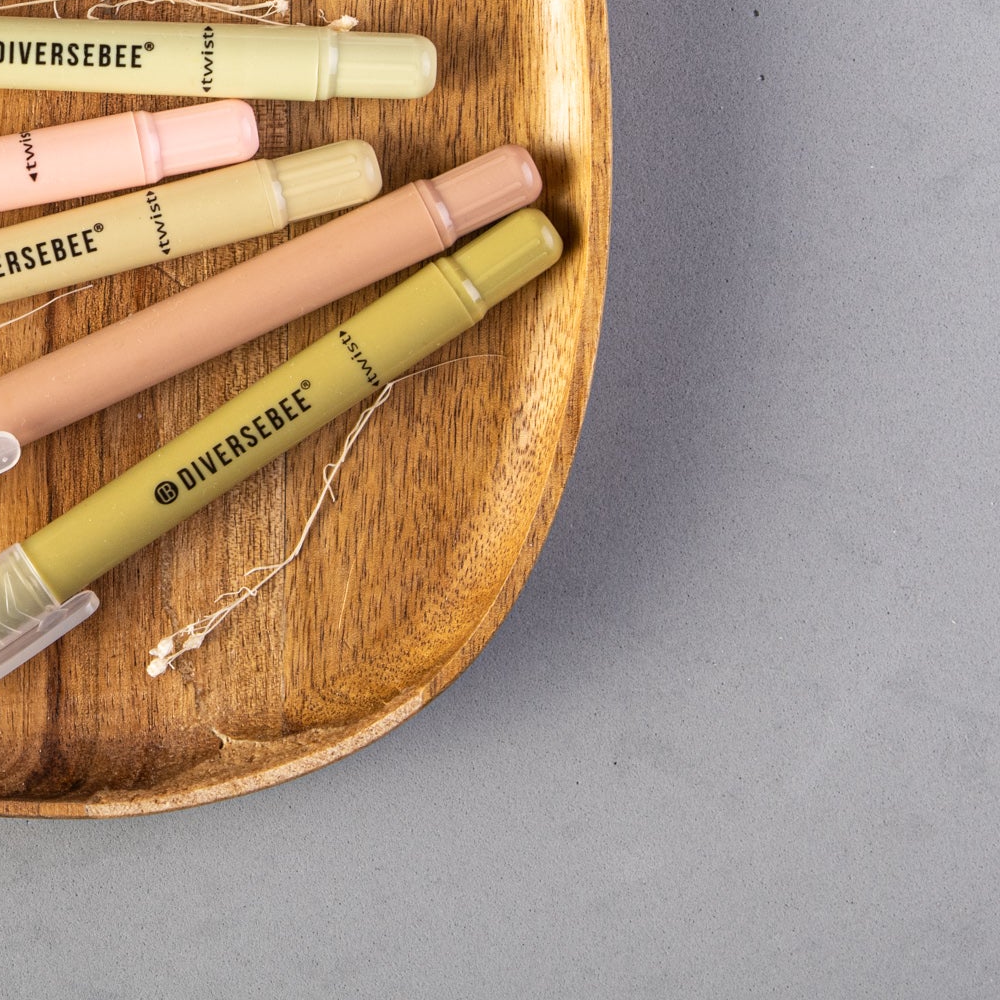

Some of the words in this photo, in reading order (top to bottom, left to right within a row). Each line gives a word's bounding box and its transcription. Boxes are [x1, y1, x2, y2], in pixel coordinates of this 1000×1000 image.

[200, 31, 215, 85] twist
[19, 131, 37, 171] twis
[146, 194, 171, 249] twist
[341, 334, 380, 384] twist
